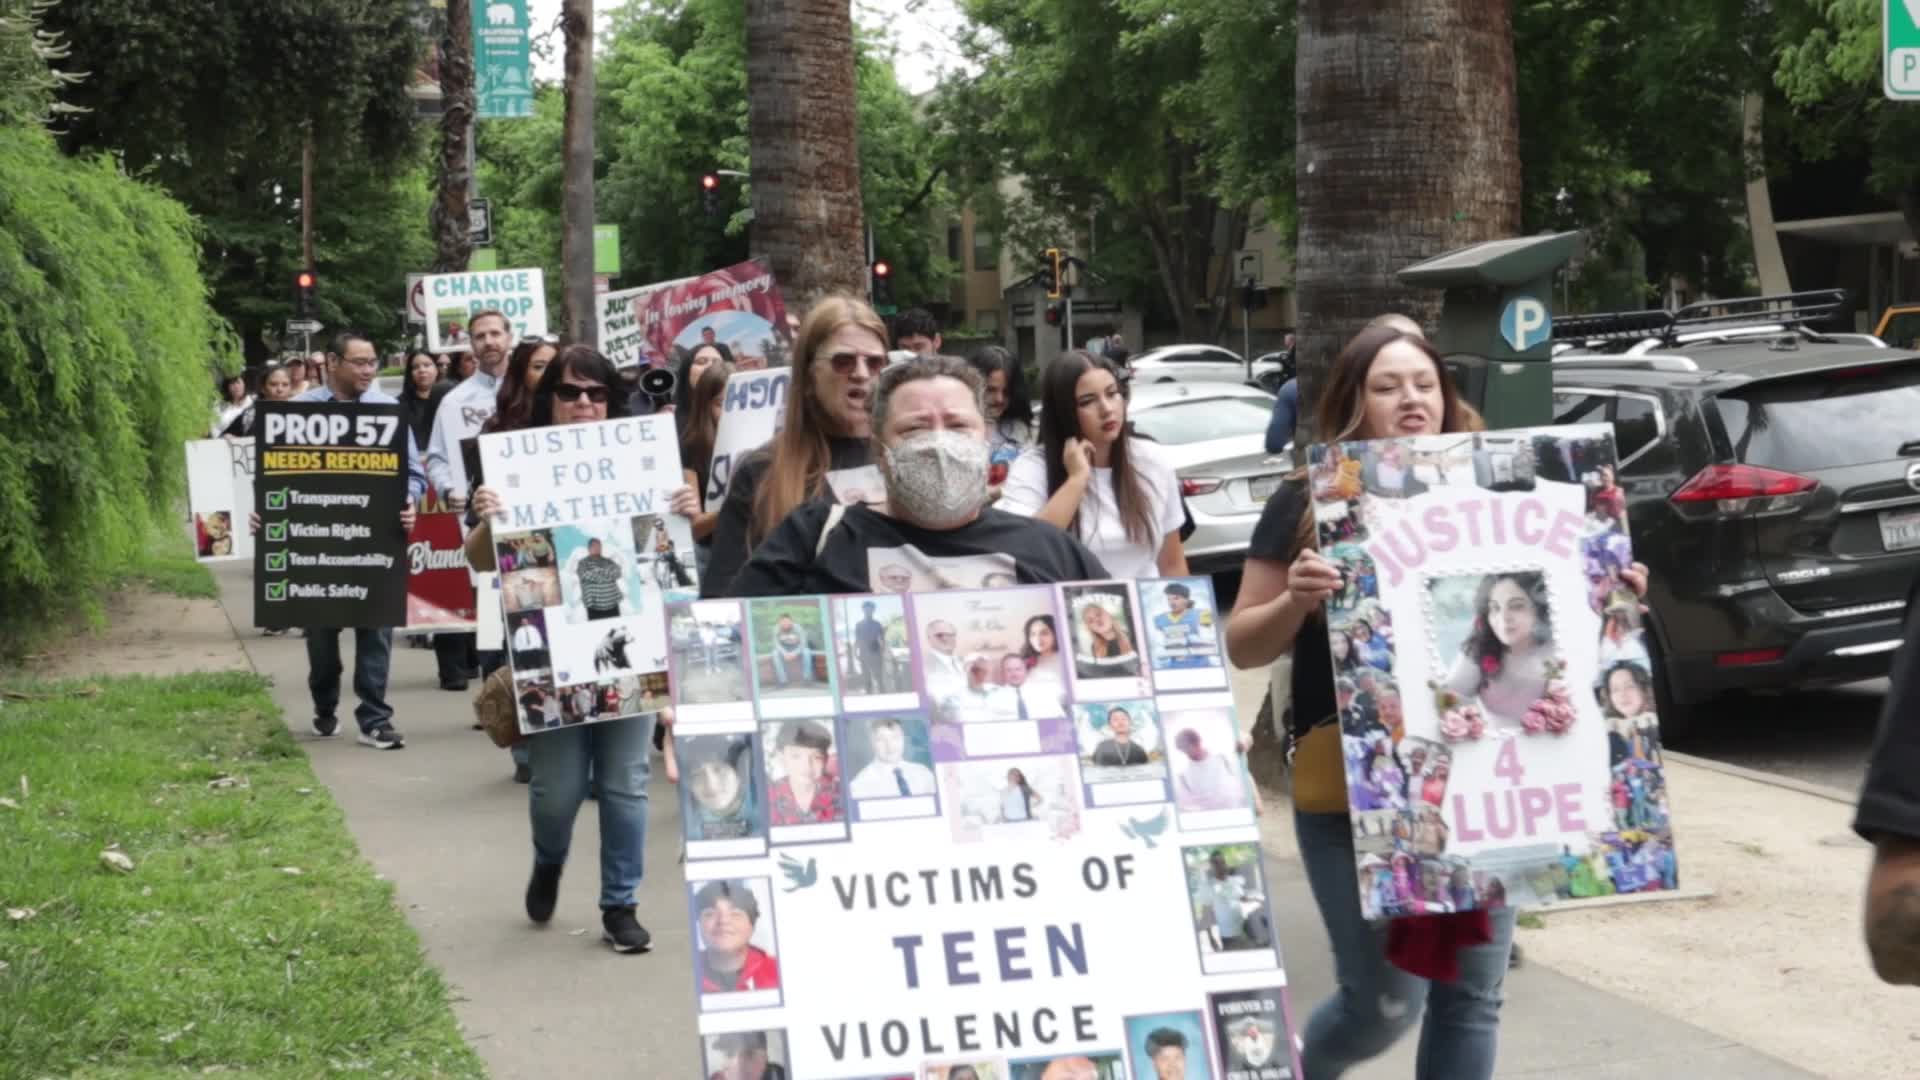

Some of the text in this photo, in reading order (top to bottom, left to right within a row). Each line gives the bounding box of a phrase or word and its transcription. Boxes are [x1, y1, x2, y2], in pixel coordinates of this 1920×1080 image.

[433, 272, 529, 297] CHANGE
[1515, 298, 1546, 351] P
[264, 413, 399, 446] PROP 57
[500, 419, 657, 459] JUSTICE
[263, 451, 399, 470] NEEDS REFORM
[552, 457, 616, 487] FOR
[289, 490, 371, 508] Transparency
[513, 488, 654, 528] MATHEW
[289, 523, 372, 540] Victim Rights
[1367, 497, 1586, 588] JUSTICE
[289, 552, 395, 569] Teen Accountability
[407, 540, 468, 575] Brand
[289, 584, 369, 600] Public Safety
[1493, 736, 1525, 785] 4
[1452, 782, 1588, 843] LUPE
[831, 854, 1135, 911] VICTIMS OF
[891, 922, 1089, 989] TEEN
[820, 1004, 1098, 1061] VIOLENCE
